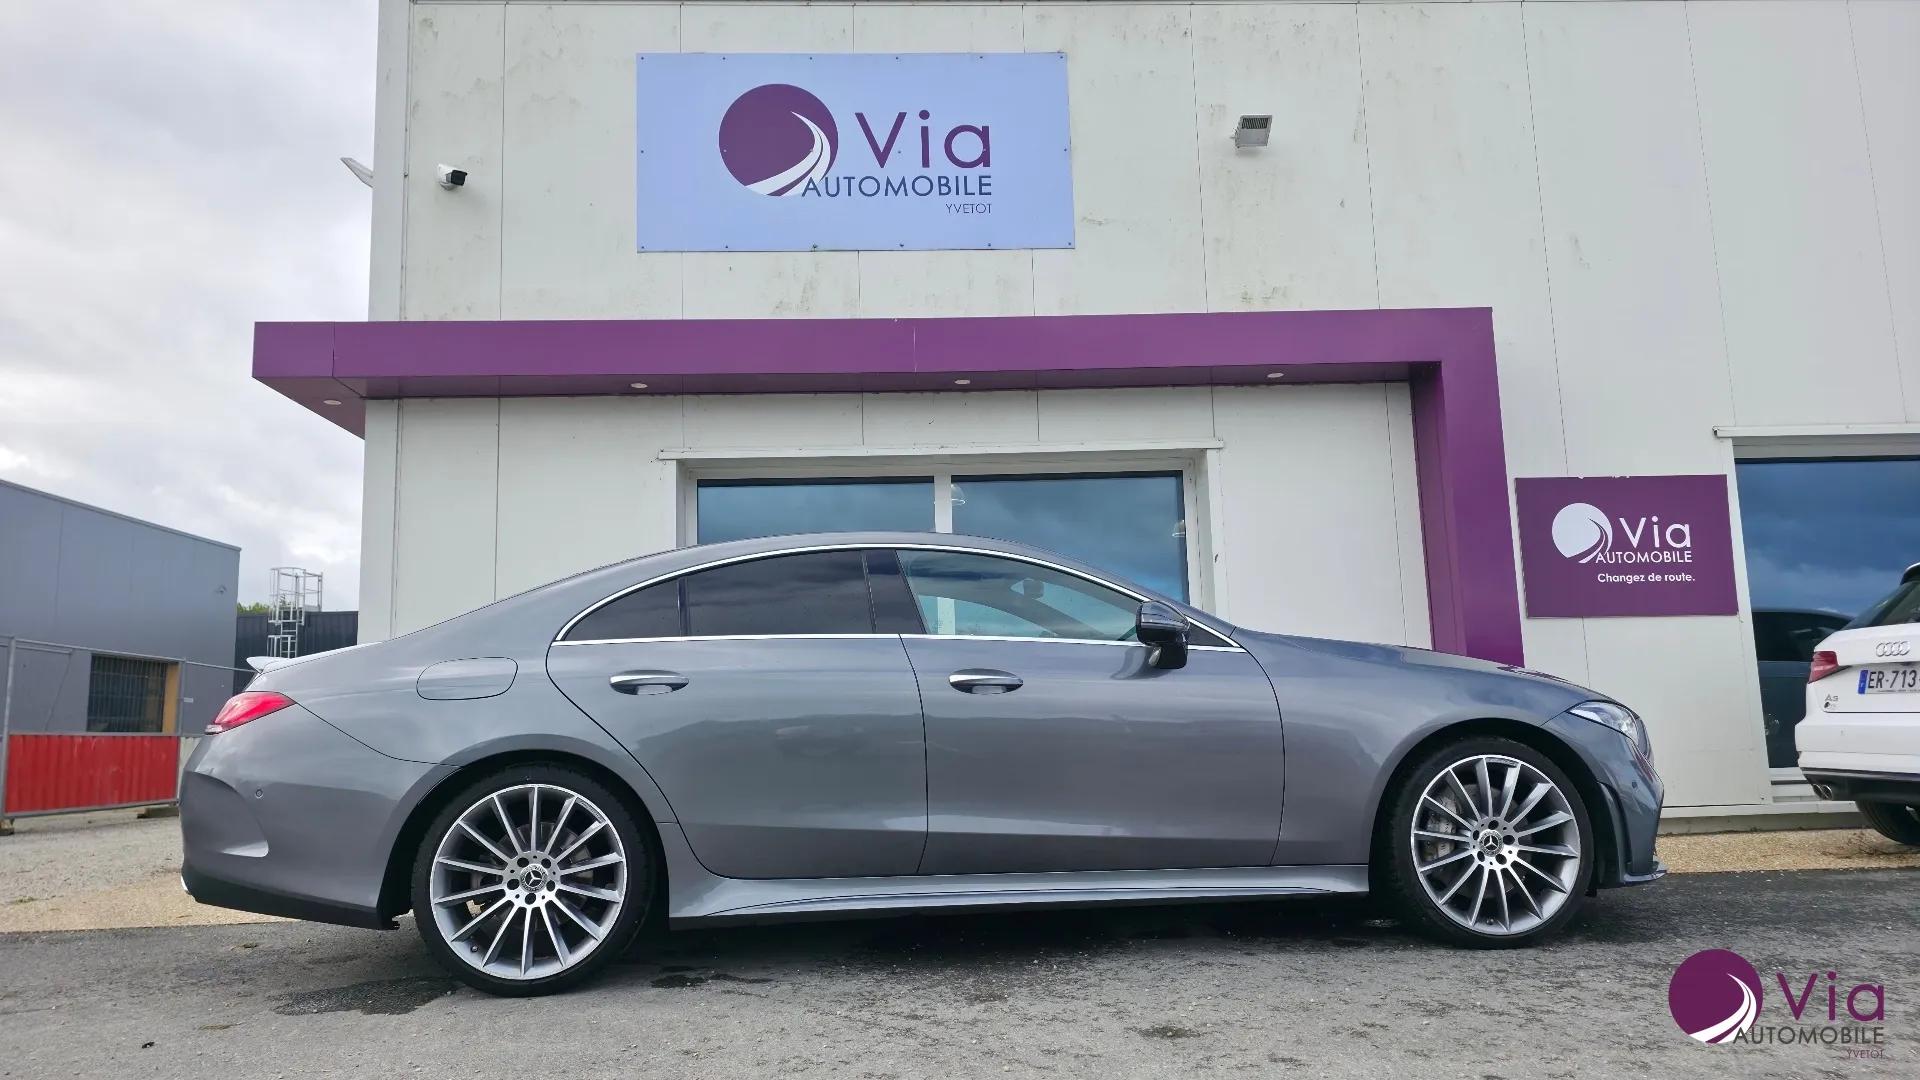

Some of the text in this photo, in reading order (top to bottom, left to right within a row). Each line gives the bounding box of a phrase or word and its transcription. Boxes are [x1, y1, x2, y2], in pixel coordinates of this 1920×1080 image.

[855, 110, 991, 168] Via
[802, 174, 992, 198] AUTOMOBILE
[945, 203, 992, 214] YVETOT
[1619, 515, 1691, 549] Via
[1595, 550, 1692, 564] AUTOMOBILE
[1597, 572, 1696, 583] Changez de route.
